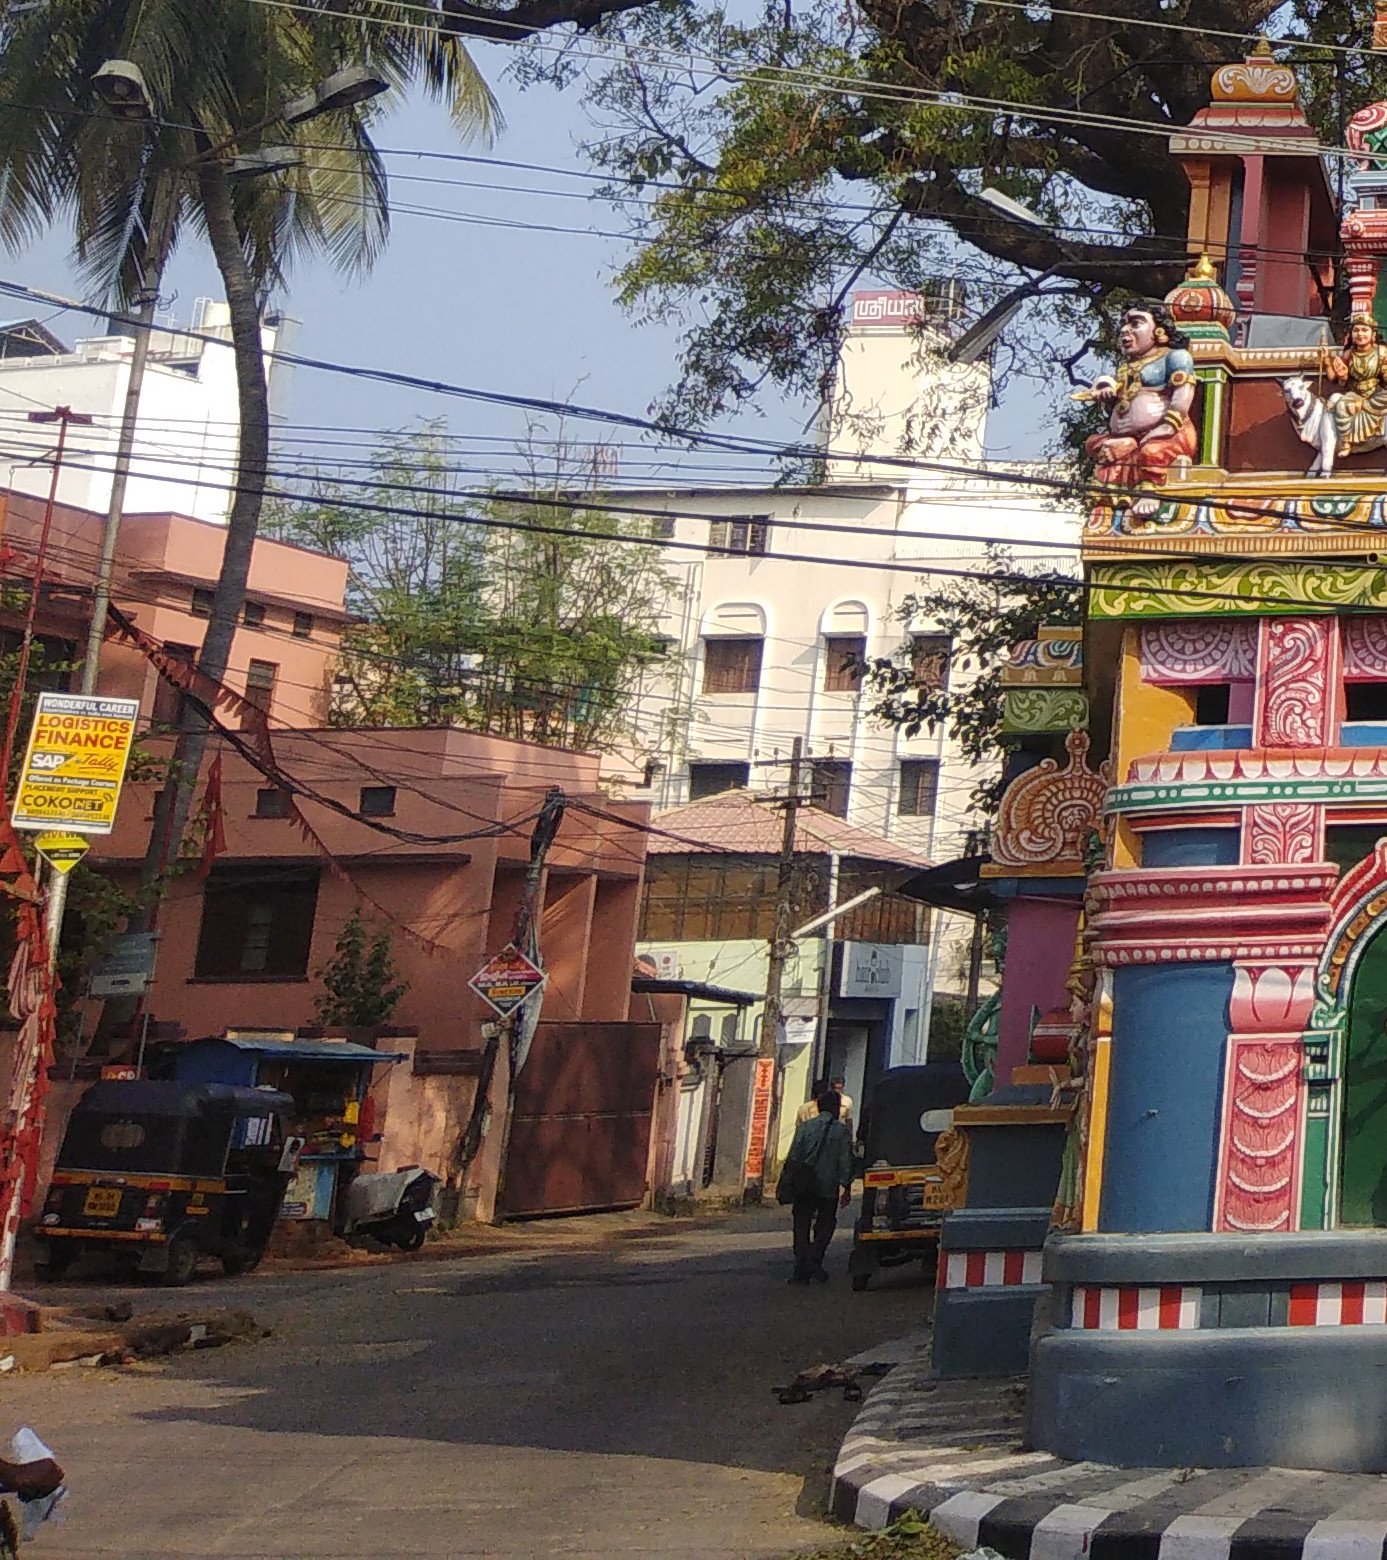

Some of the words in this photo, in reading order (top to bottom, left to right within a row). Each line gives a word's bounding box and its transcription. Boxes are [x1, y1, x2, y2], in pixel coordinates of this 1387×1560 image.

[43, 698, 98, 711] WONDERFUL
[99, 703, 135, 715] CAREER
[37, 715, 130, 734] LOGISTICS
[34, 729, 128, 751] FINANCE
[31, 753, 65, 768] SAP
[82, 752, 119, 772] Tally
[25, 783, 66, 793] PLACEMENT
[67, 786, 99, 795] SUPPORT
[28, 774, 53, 783] Offered
[62, 775, 90, 787] Package
[90, 779, 117, 789] Courses
